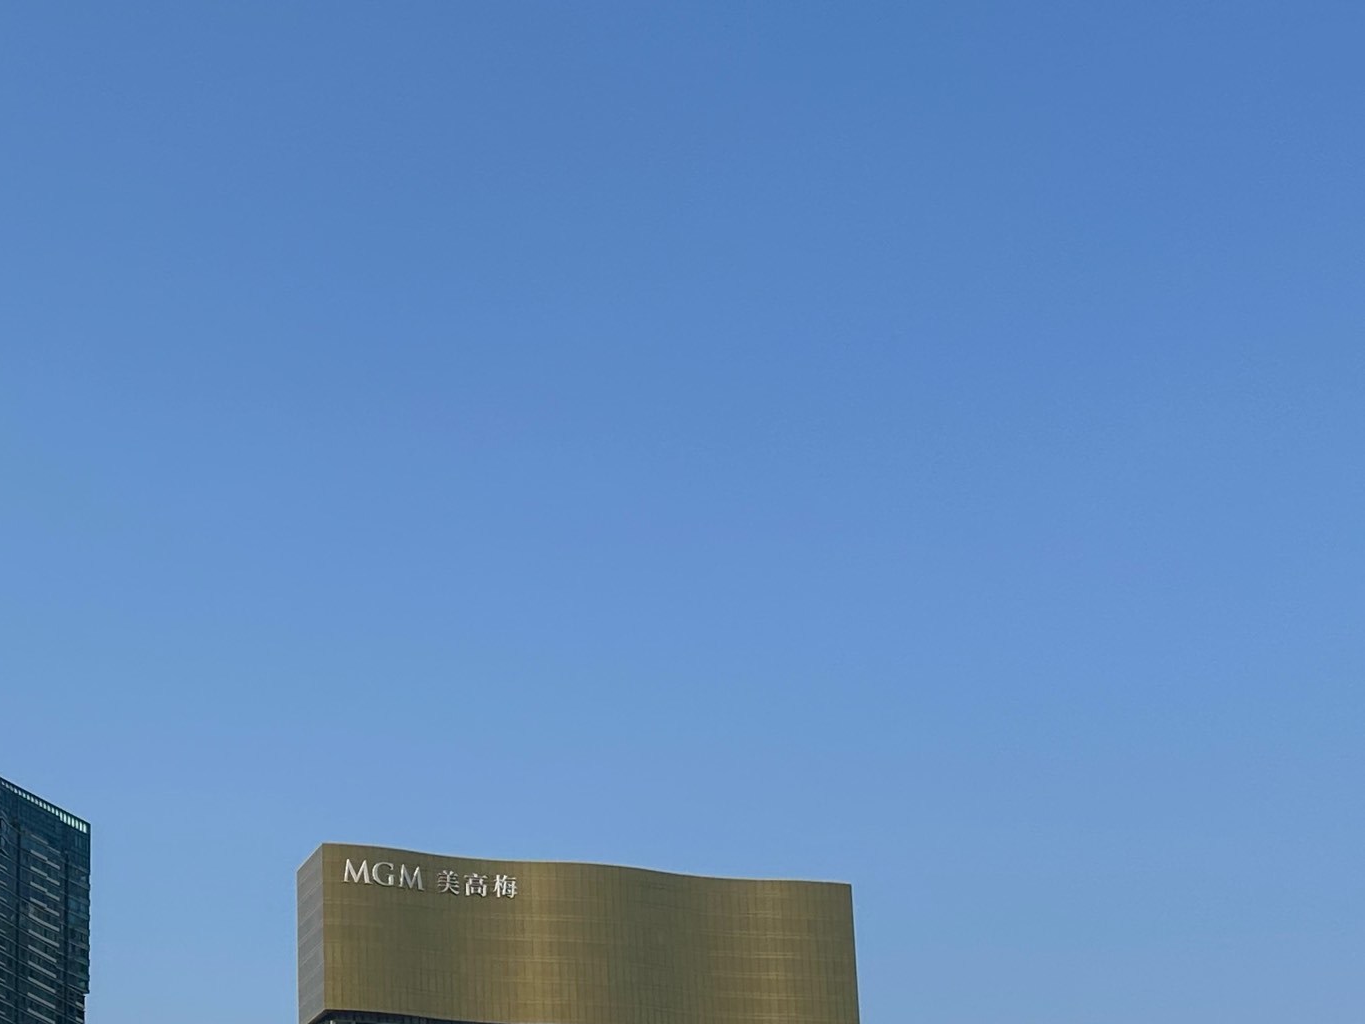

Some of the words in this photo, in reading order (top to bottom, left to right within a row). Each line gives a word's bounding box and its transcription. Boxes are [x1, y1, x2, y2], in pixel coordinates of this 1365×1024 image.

[342, 858, 425, 891] MGM
[437, 870, 518, 899] 美高梅
